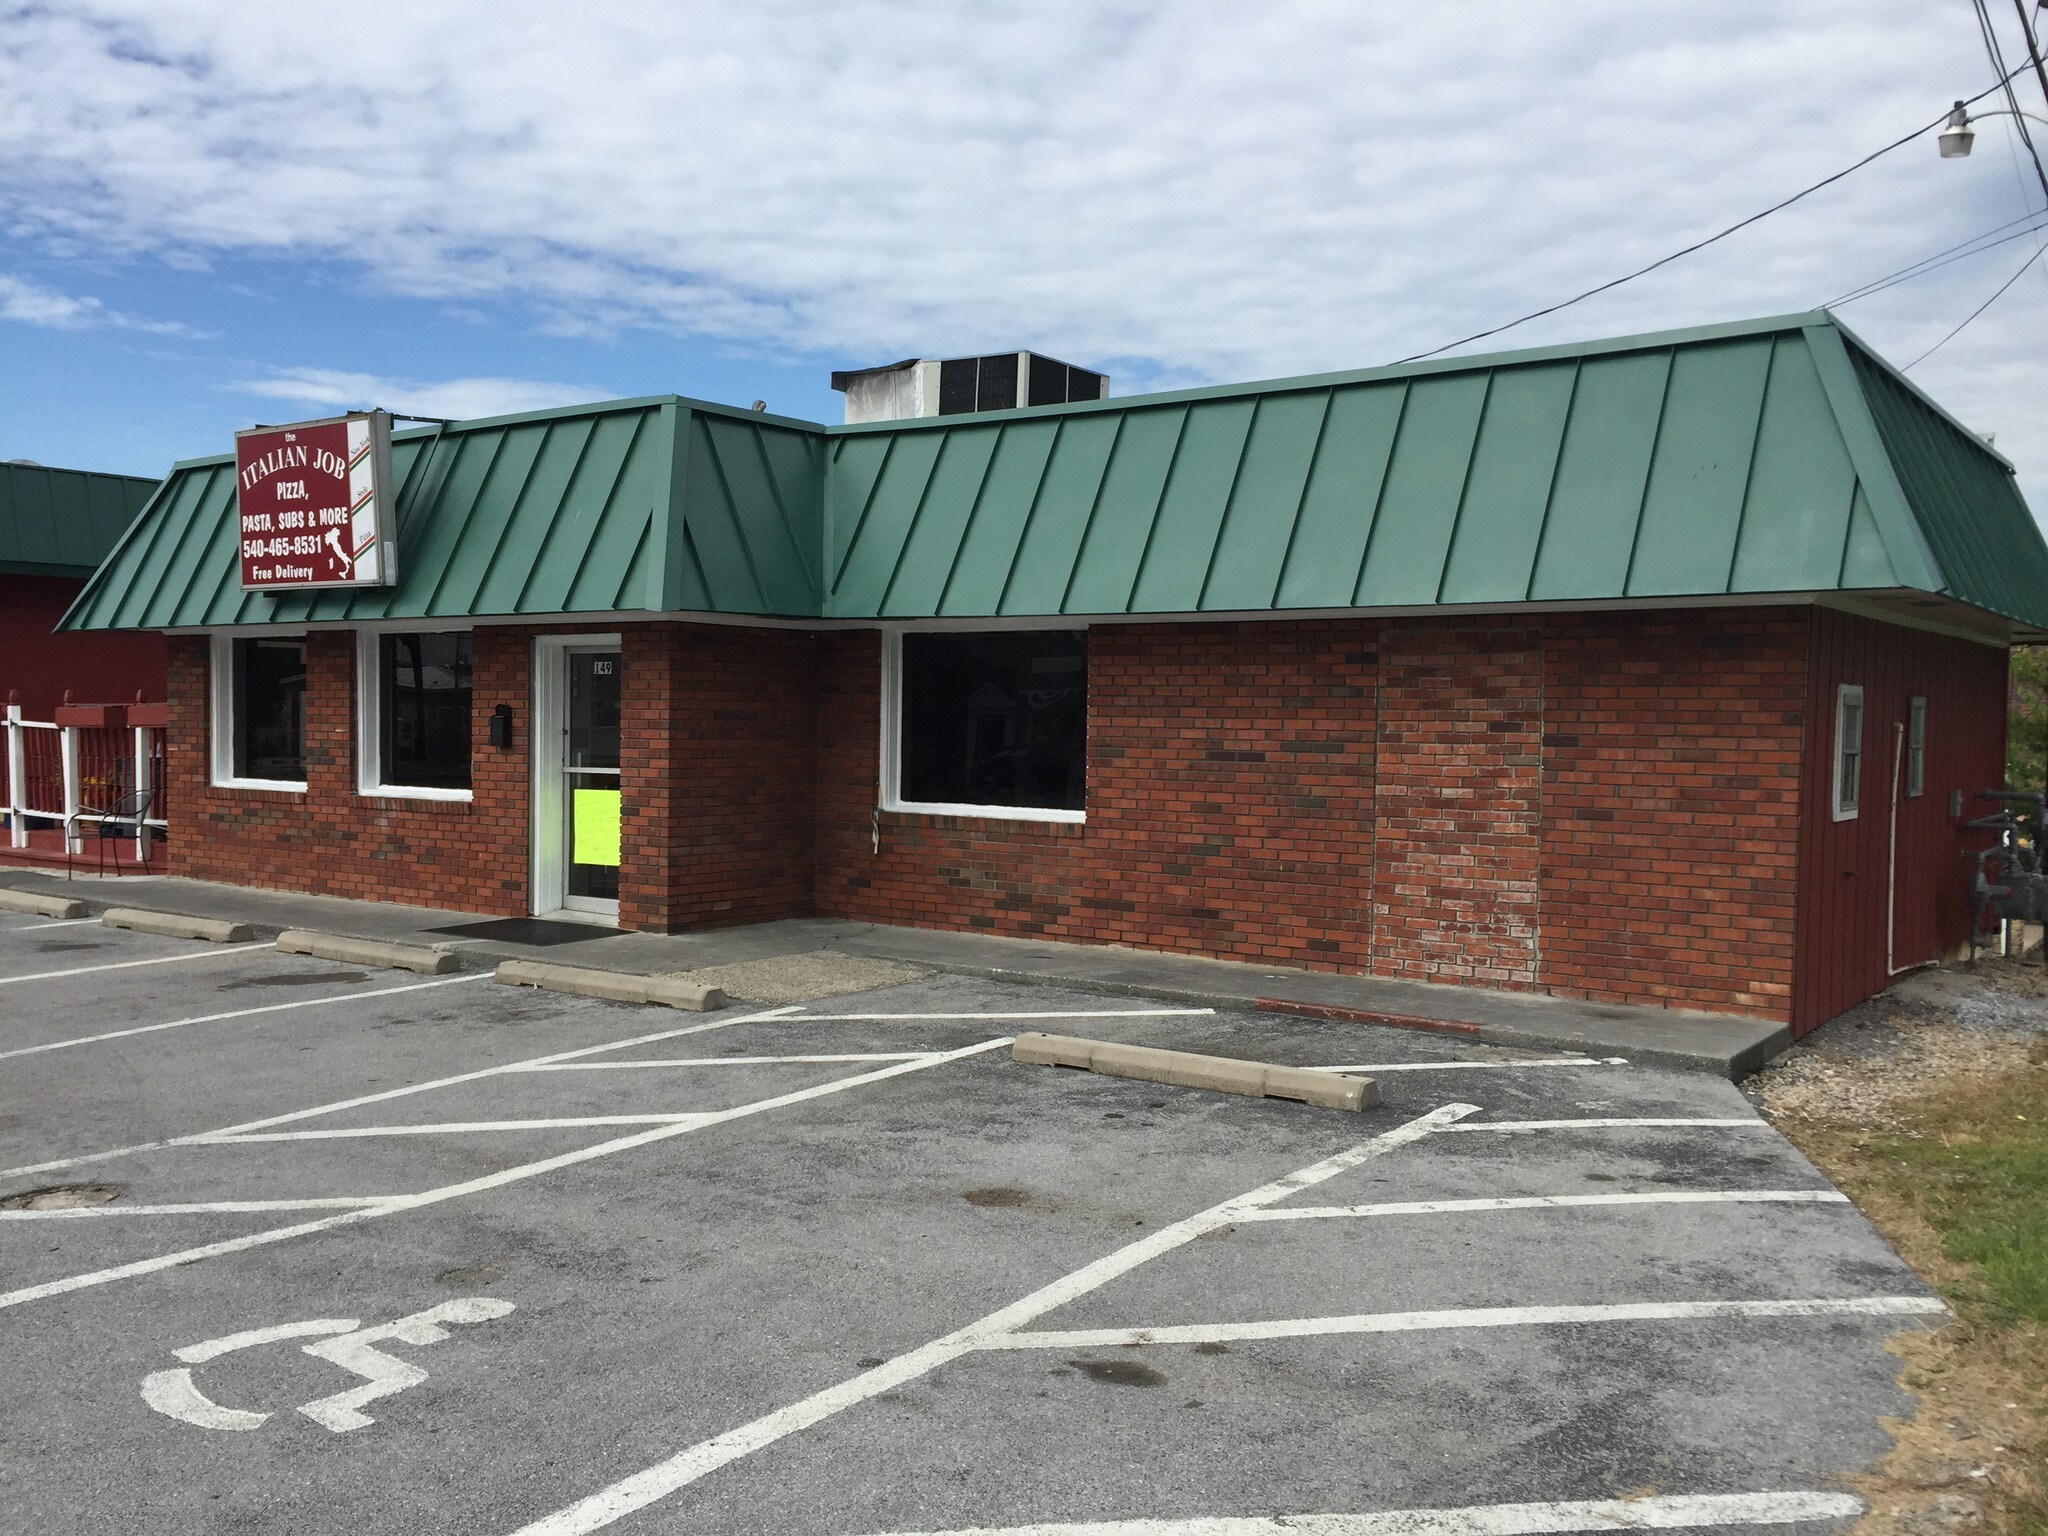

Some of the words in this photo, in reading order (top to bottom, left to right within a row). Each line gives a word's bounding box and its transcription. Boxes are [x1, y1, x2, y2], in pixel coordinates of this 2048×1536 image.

[285, 432, 296, 442] the
[241, 445, 308, 491] ITALIAN
[312, 448, 346, 480] JOB
[276, 480, 309, 500] PIZZA,
[242, 513, 275, 533] PASTA,
[278, 511, 304, 530] SUBS
[308, 511, 316, 527] &
[319, 507, 348, 525] MORE
[243, 535, 322, 558] 540-465-8531
[252, 566, 273, 580] Free
[275, 564, 313, 581] Delivery
[594, 662, 612, 675] 149
